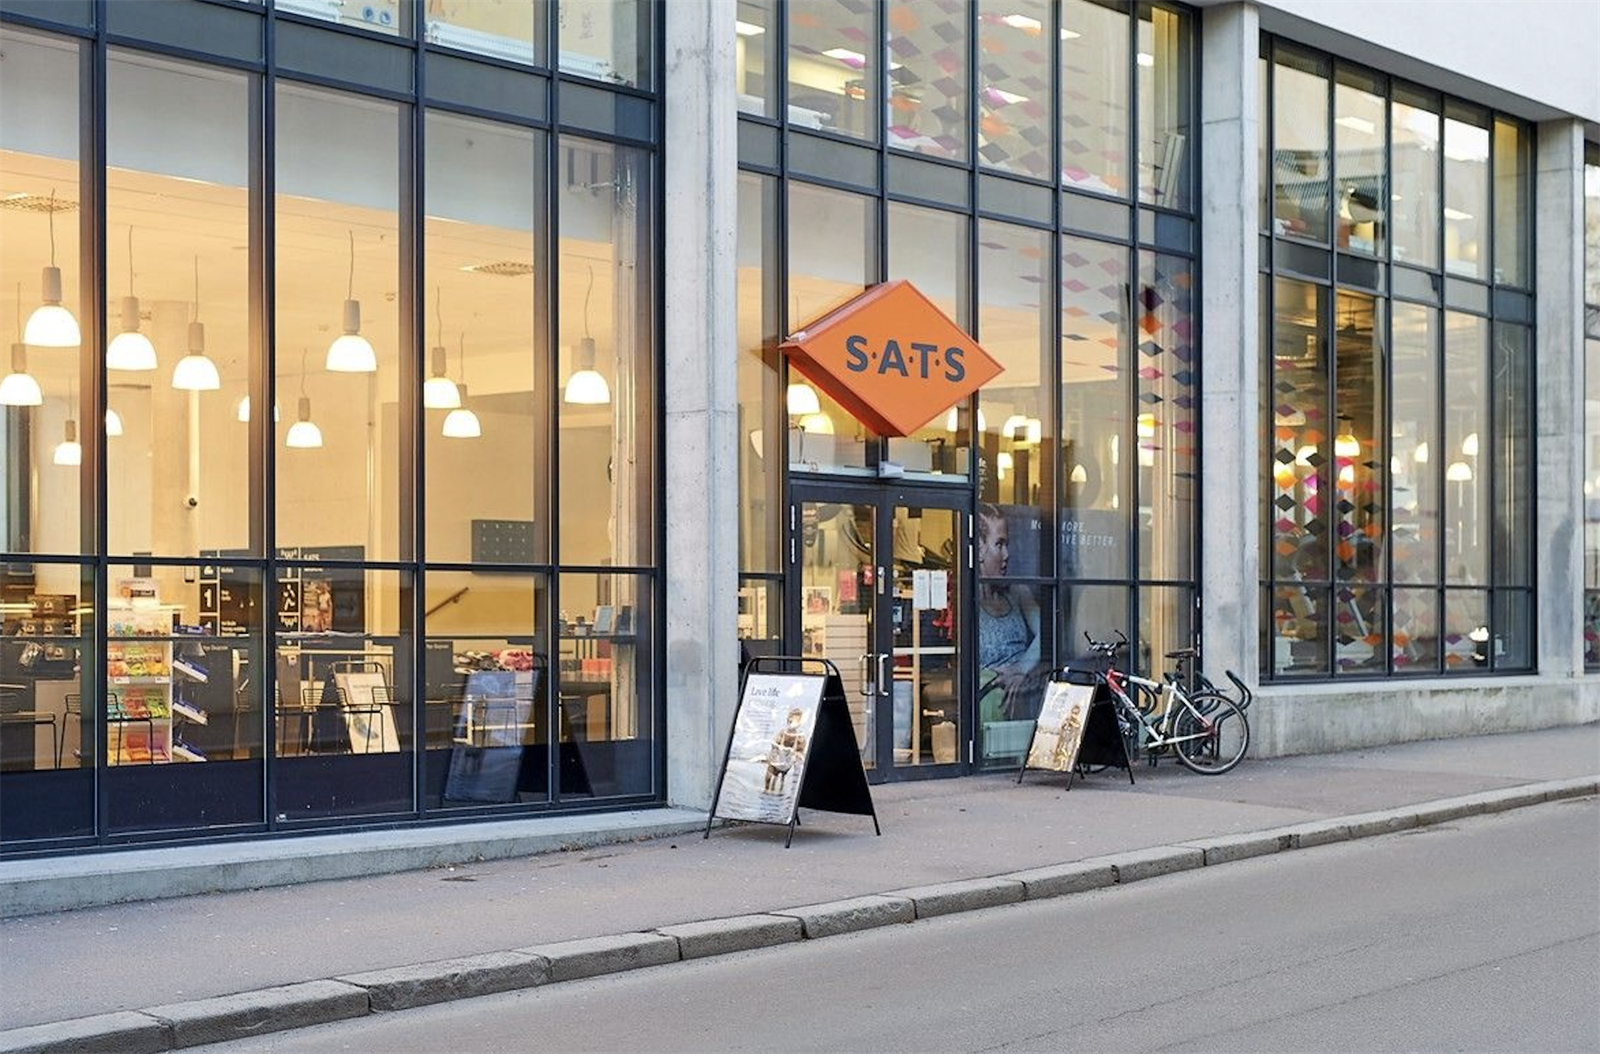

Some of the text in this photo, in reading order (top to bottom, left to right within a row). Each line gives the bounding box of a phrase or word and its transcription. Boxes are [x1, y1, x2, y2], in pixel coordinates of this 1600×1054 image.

[1061, 534, 1076, 545] IVE
[204, 588, 212, 608] 1
[751, 687, 767, 696] Live
